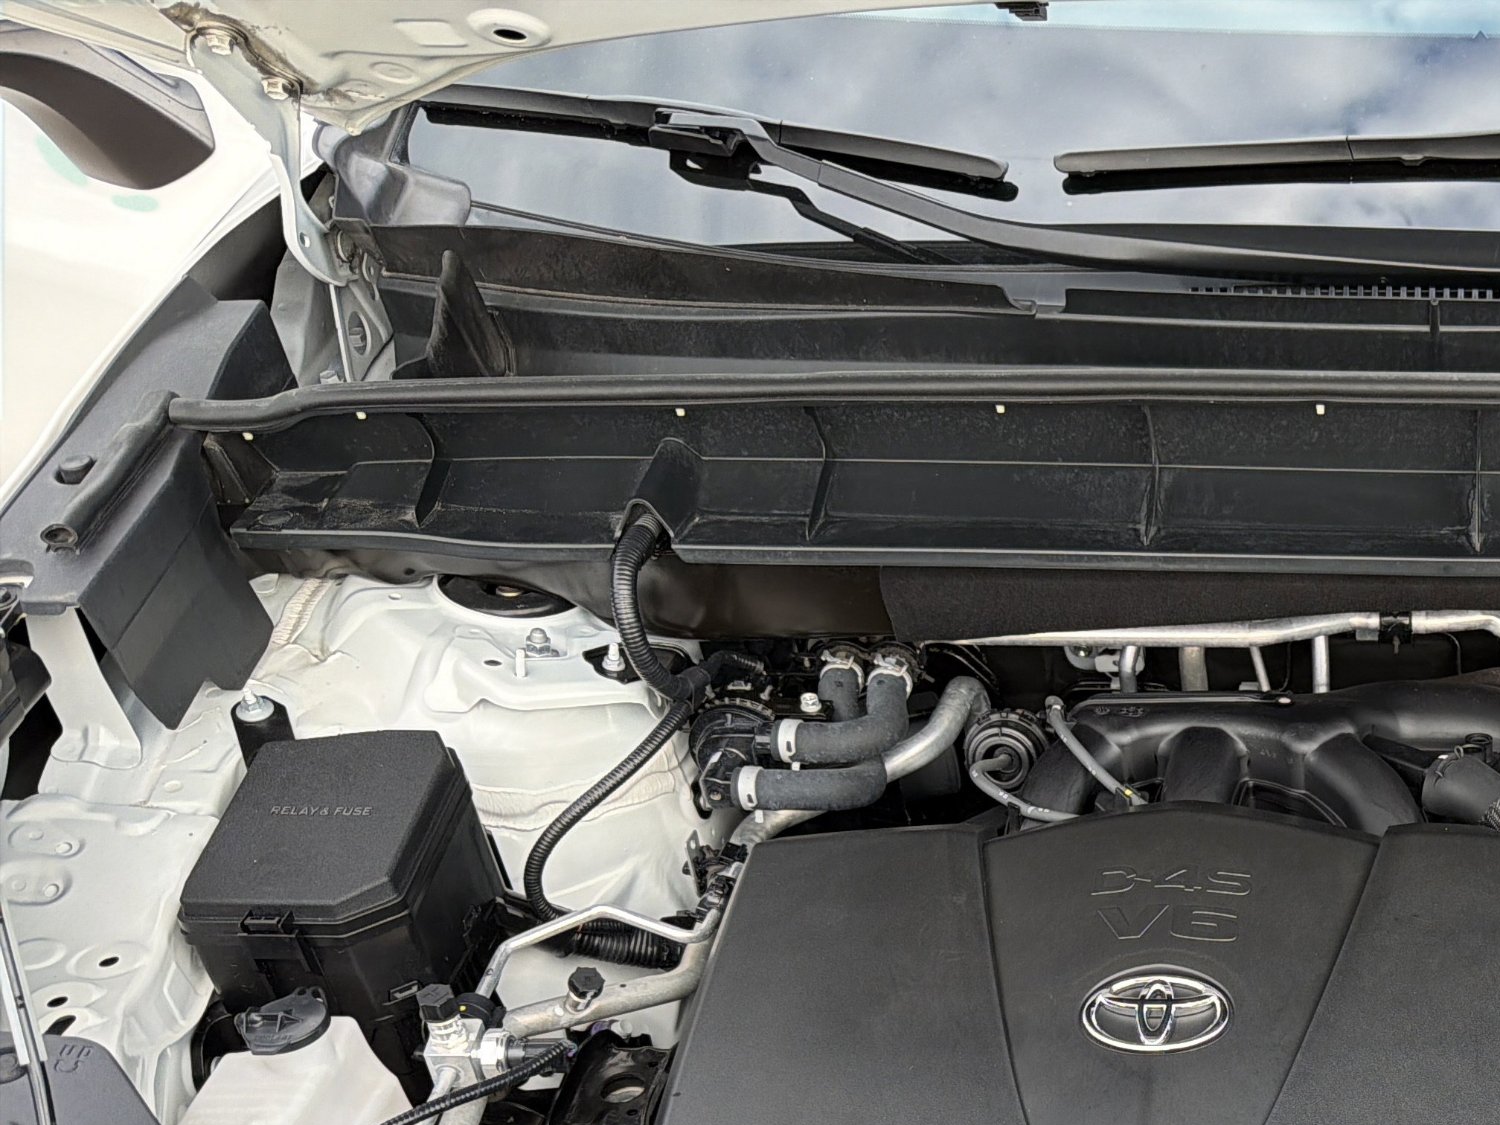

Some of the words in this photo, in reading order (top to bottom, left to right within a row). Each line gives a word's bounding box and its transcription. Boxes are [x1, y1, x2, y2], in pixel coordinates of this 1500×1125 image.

[270, 805, 320, 817] RELAY
[320, 806, 329, 816] &
[333, 806, 373, 816] FUSE
[1098, 903, 1239, 942] V6
